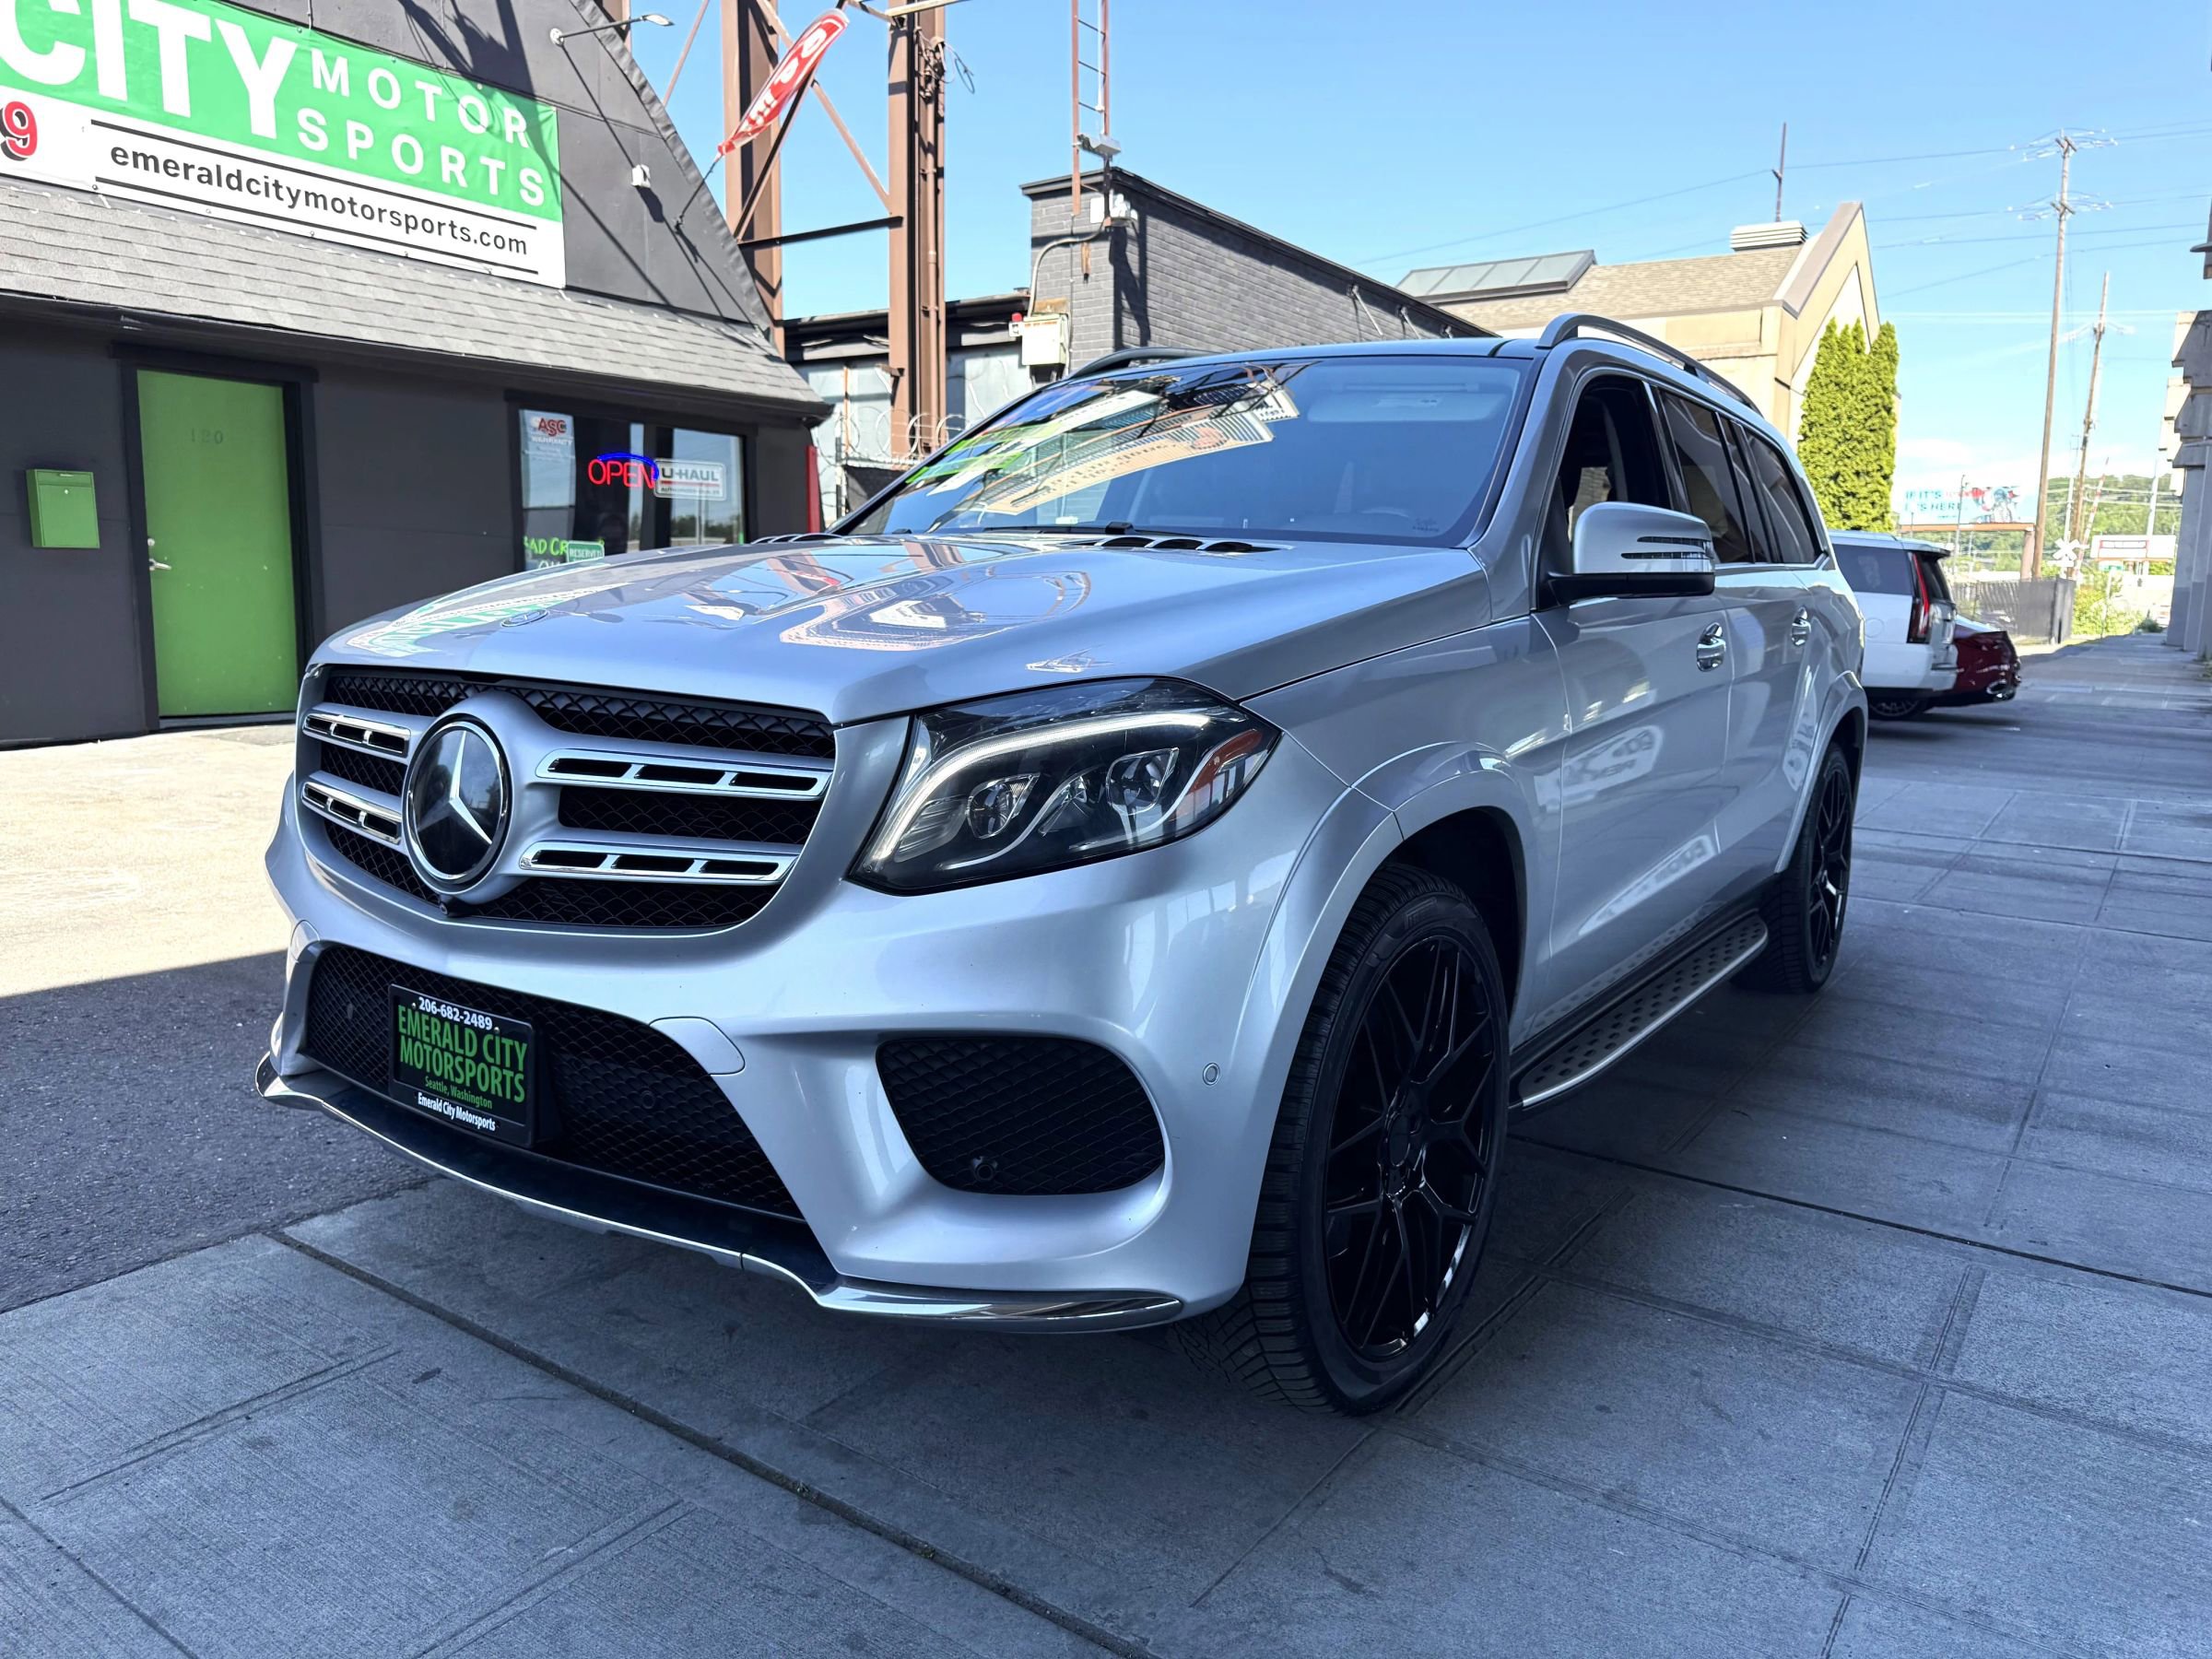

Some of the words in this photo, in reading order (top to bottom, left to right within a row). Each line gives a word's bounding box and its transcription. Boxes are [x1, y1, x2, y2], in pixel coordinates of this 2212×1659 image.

[0, 0, 299, 140] CITY
[312, 49, 528, 148] MOTOR
[297, 107, 546, 206] SPORTS
[110, 143, 528, 255] emeraldcitymotorsports.com
[538, 418, 567, 437] ASC
[587, 458, 655, 489] OPEN
[661, 467, 719, 482] U-HAUL
[398, 1005, 477, 1058] EMERALD
[483, 1033, 528, 1072] CITY
[418, 996, 493, 1030] 206-682-2489
[400, 1035, 525, 1103] MOTORSPORTS
[425, 1076, 450, 1095] Seattle,
[450, 1085, 493, 1109] Washington
[418, 1091, 442, 1112] Emerald
[442, 1101, 456, 1120] City
[455, 1106, 496, 1131] Motorsports
